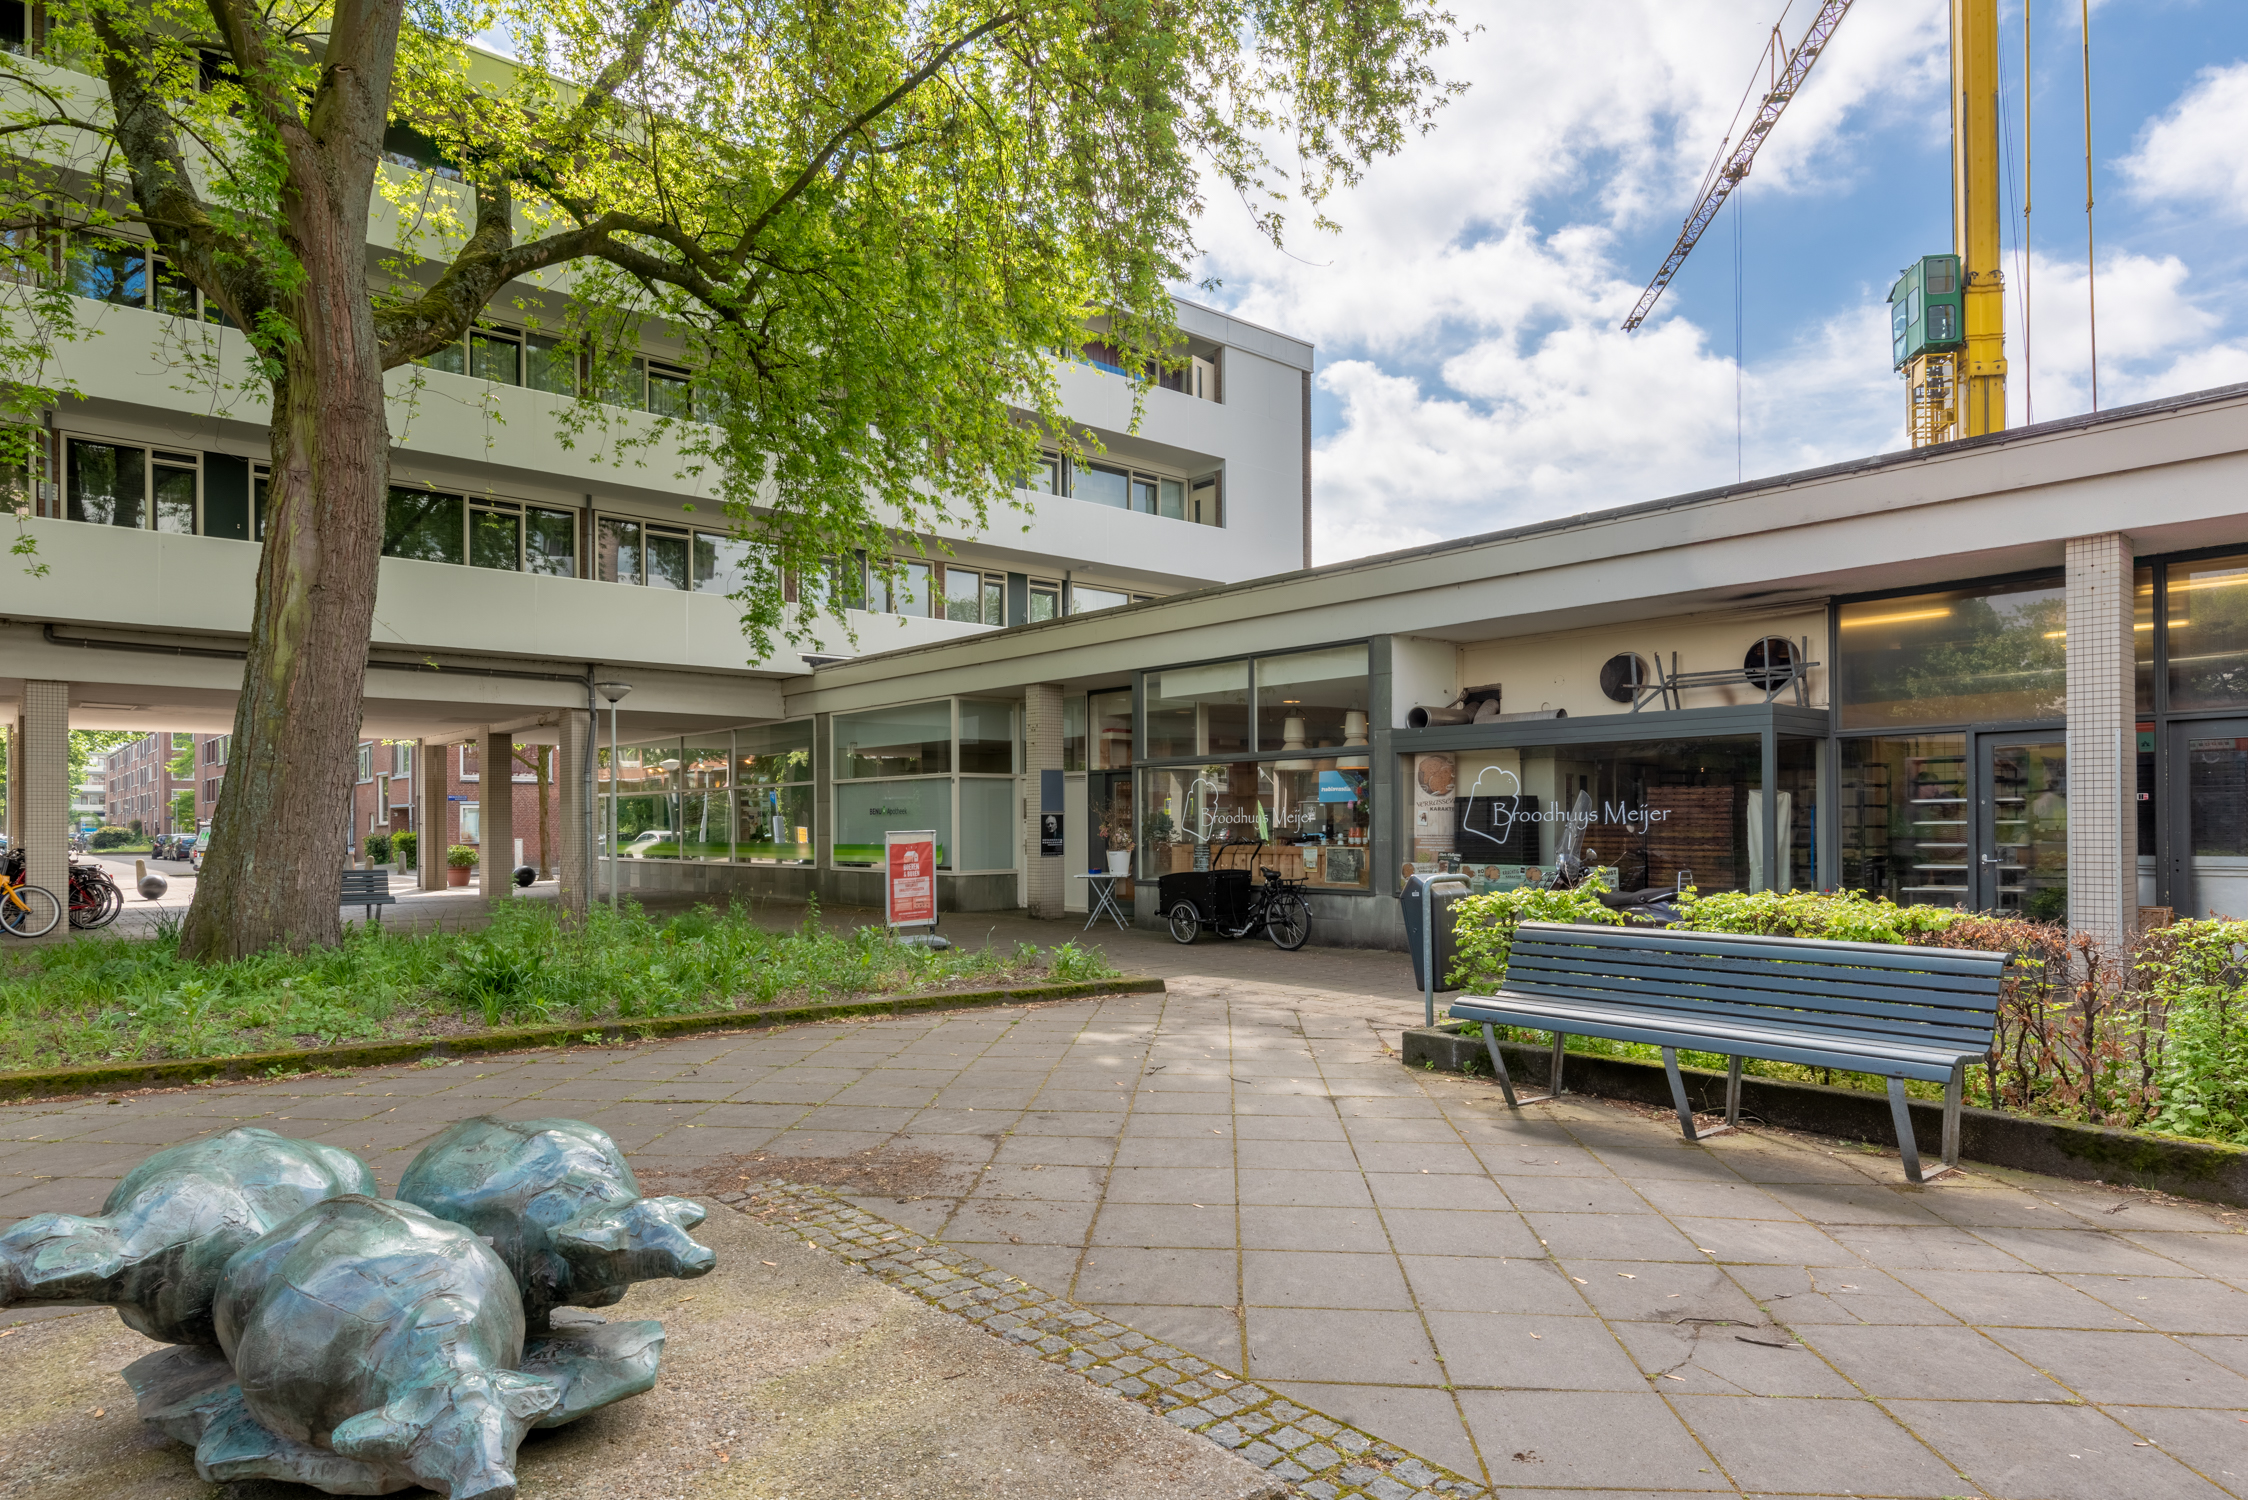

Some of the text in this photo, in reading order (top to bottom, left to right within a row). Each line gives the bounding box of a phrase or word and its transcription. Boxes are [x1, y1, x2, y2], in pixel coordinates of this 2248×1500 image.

[887, 807, 907, 816] Apotheek
[1201, 806, 1314, 834] Broodhuys Meijer
[1493, 801, 1671, 834] Broodhuys Meijer
